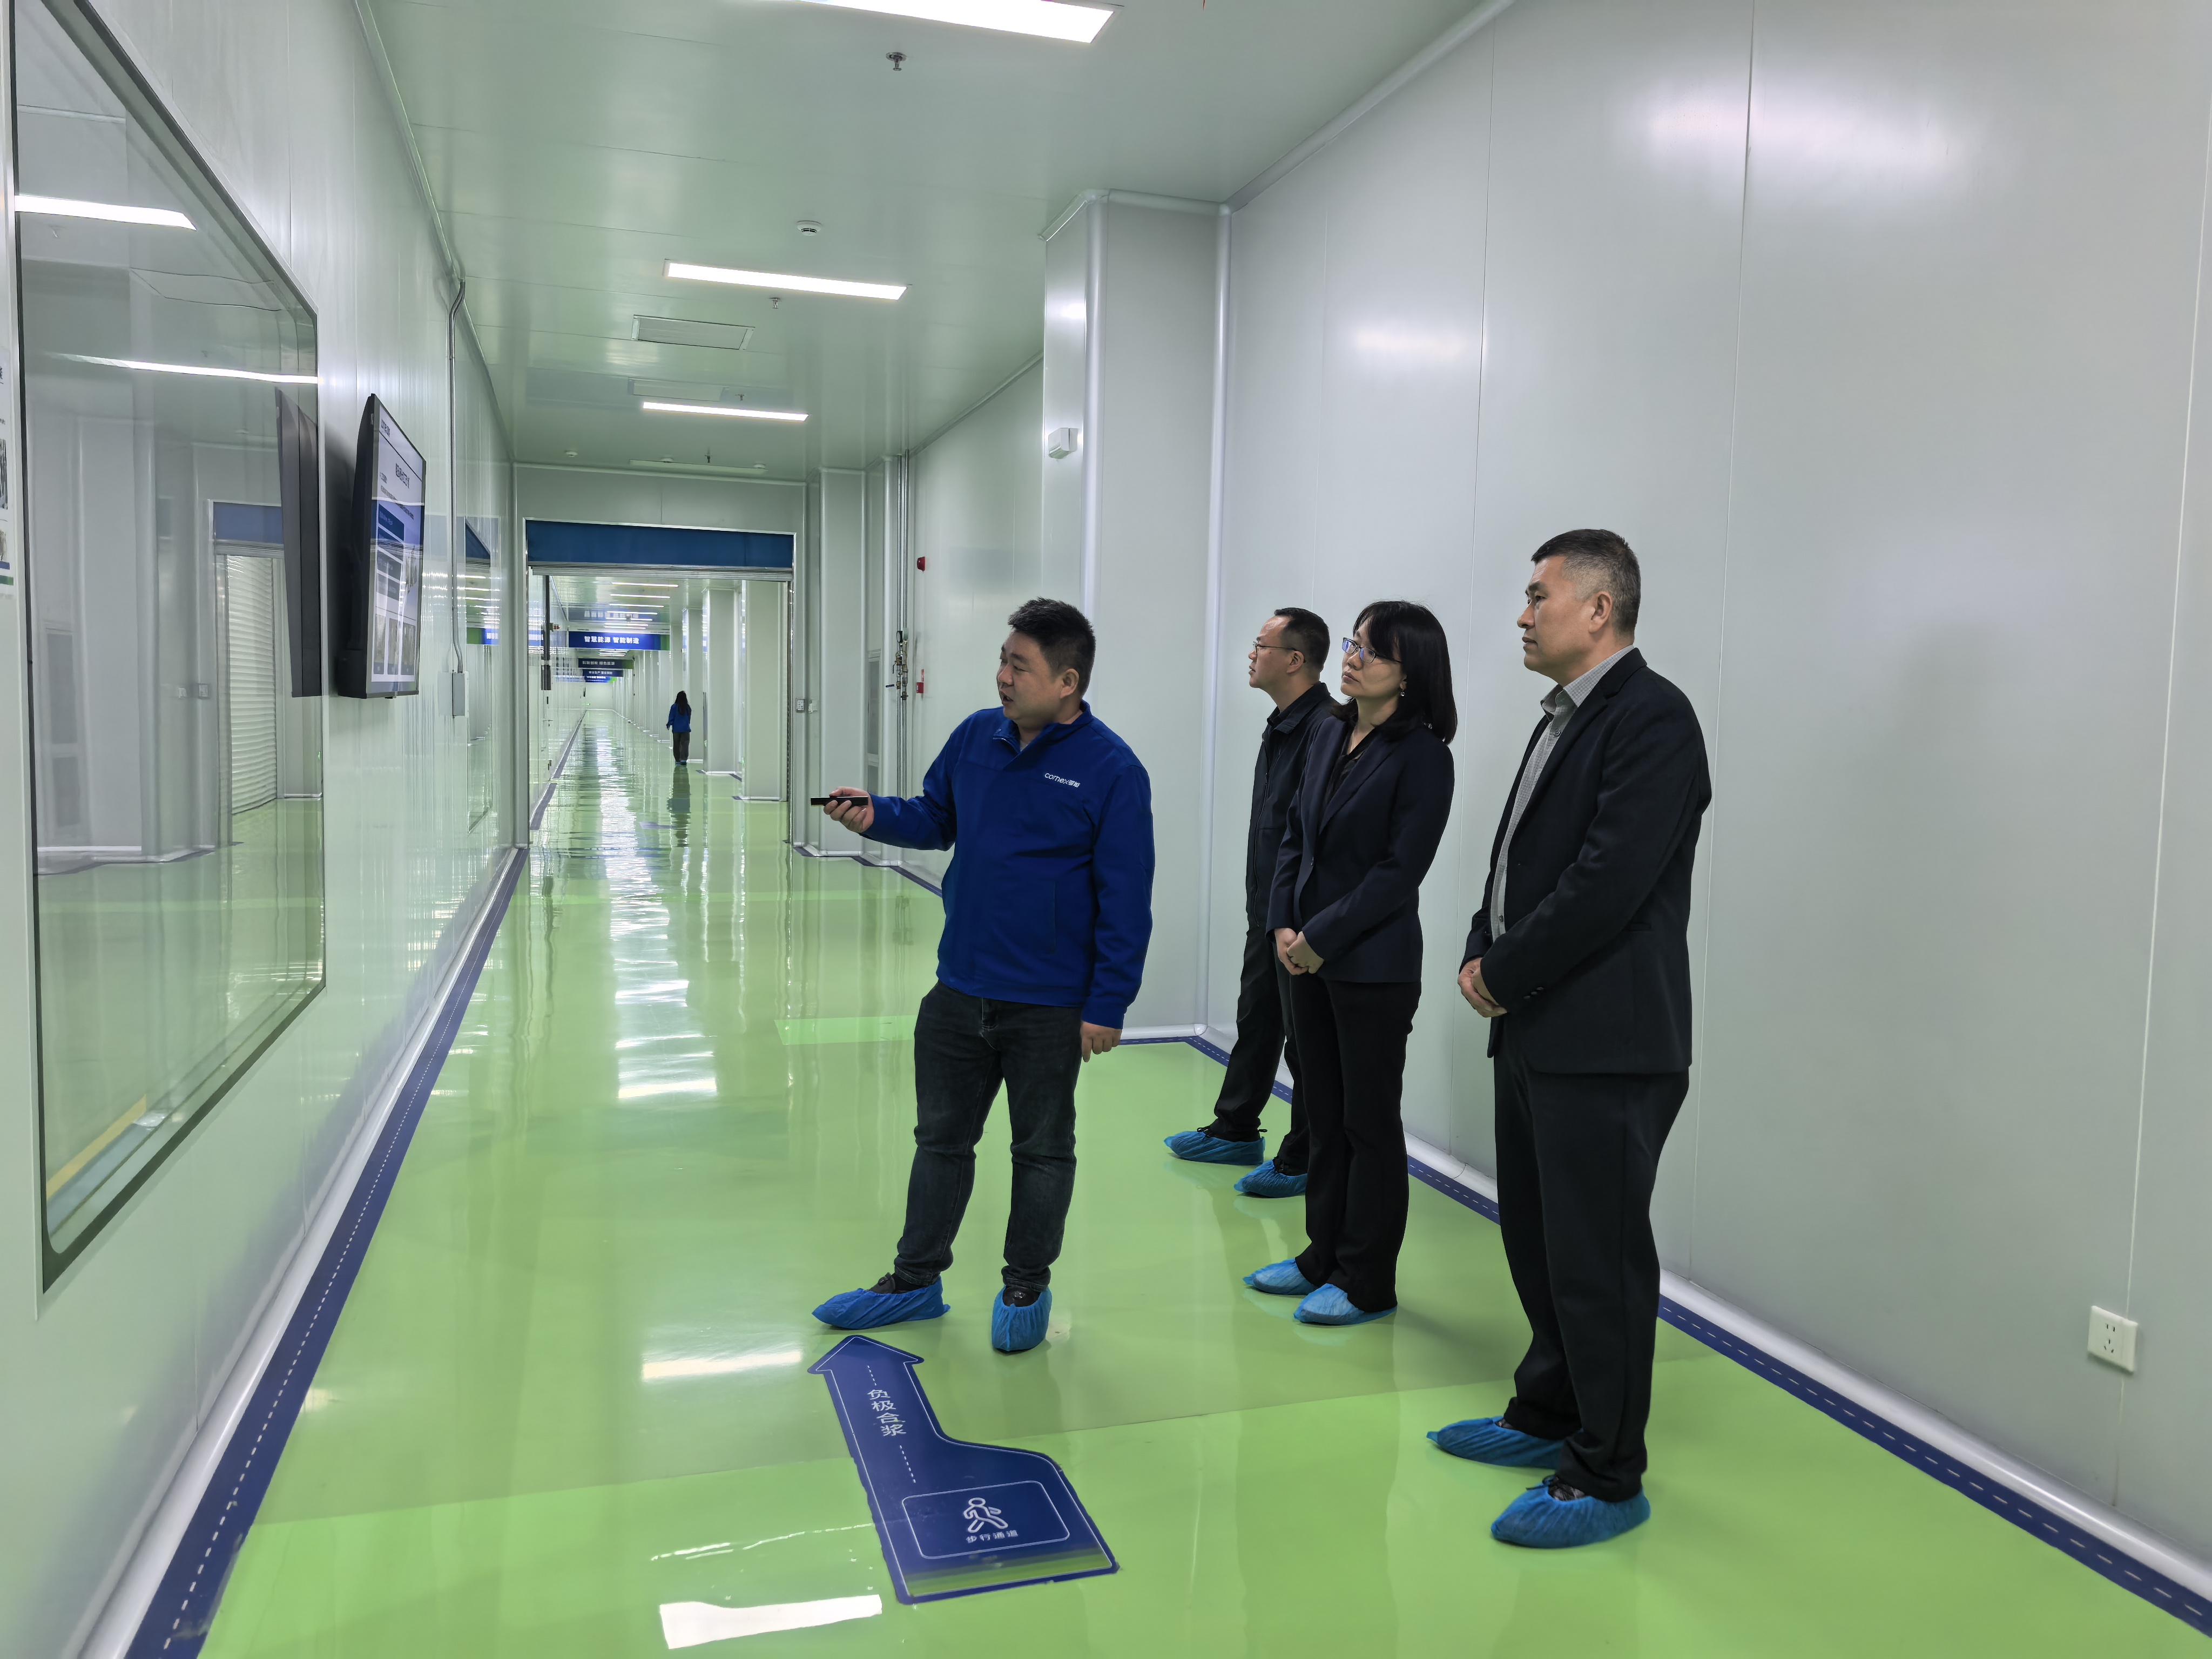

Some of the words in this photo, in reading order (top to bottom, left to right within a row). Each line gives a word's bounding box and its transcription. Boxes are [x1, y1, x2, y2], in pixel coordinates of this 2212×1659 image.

[867, 1389, 907, 1437] 负极合浆
[966, 1529, 1019, 1543] 步行通道
